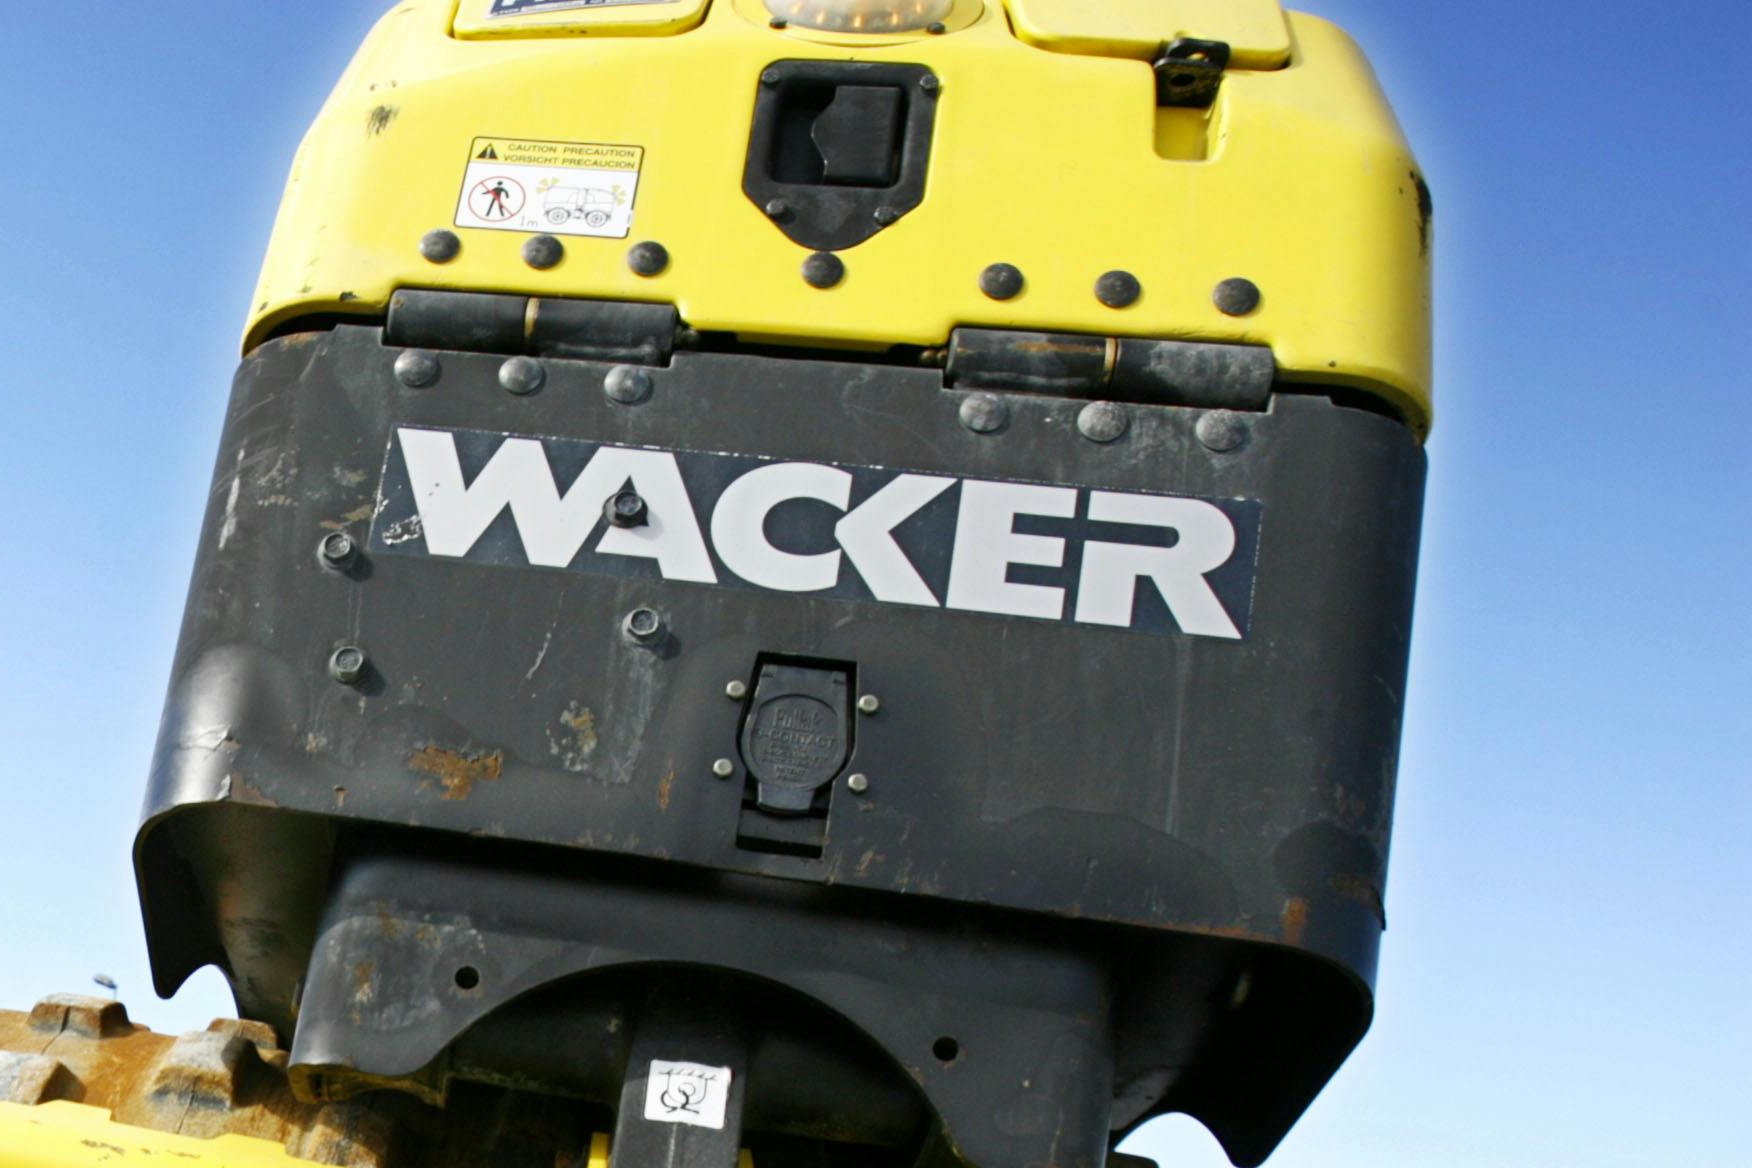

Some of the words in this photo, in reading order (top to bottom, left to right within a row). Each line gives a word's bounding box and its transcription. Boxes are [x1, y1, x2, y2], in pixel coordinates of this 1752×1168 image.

[508, 143, 557, 154] CAUTION
[563, 146, 635, 158] PRECAUTION
[503, 154, 558, 165] VORSICHT
[397, 427, 1243, 640] WACKER
